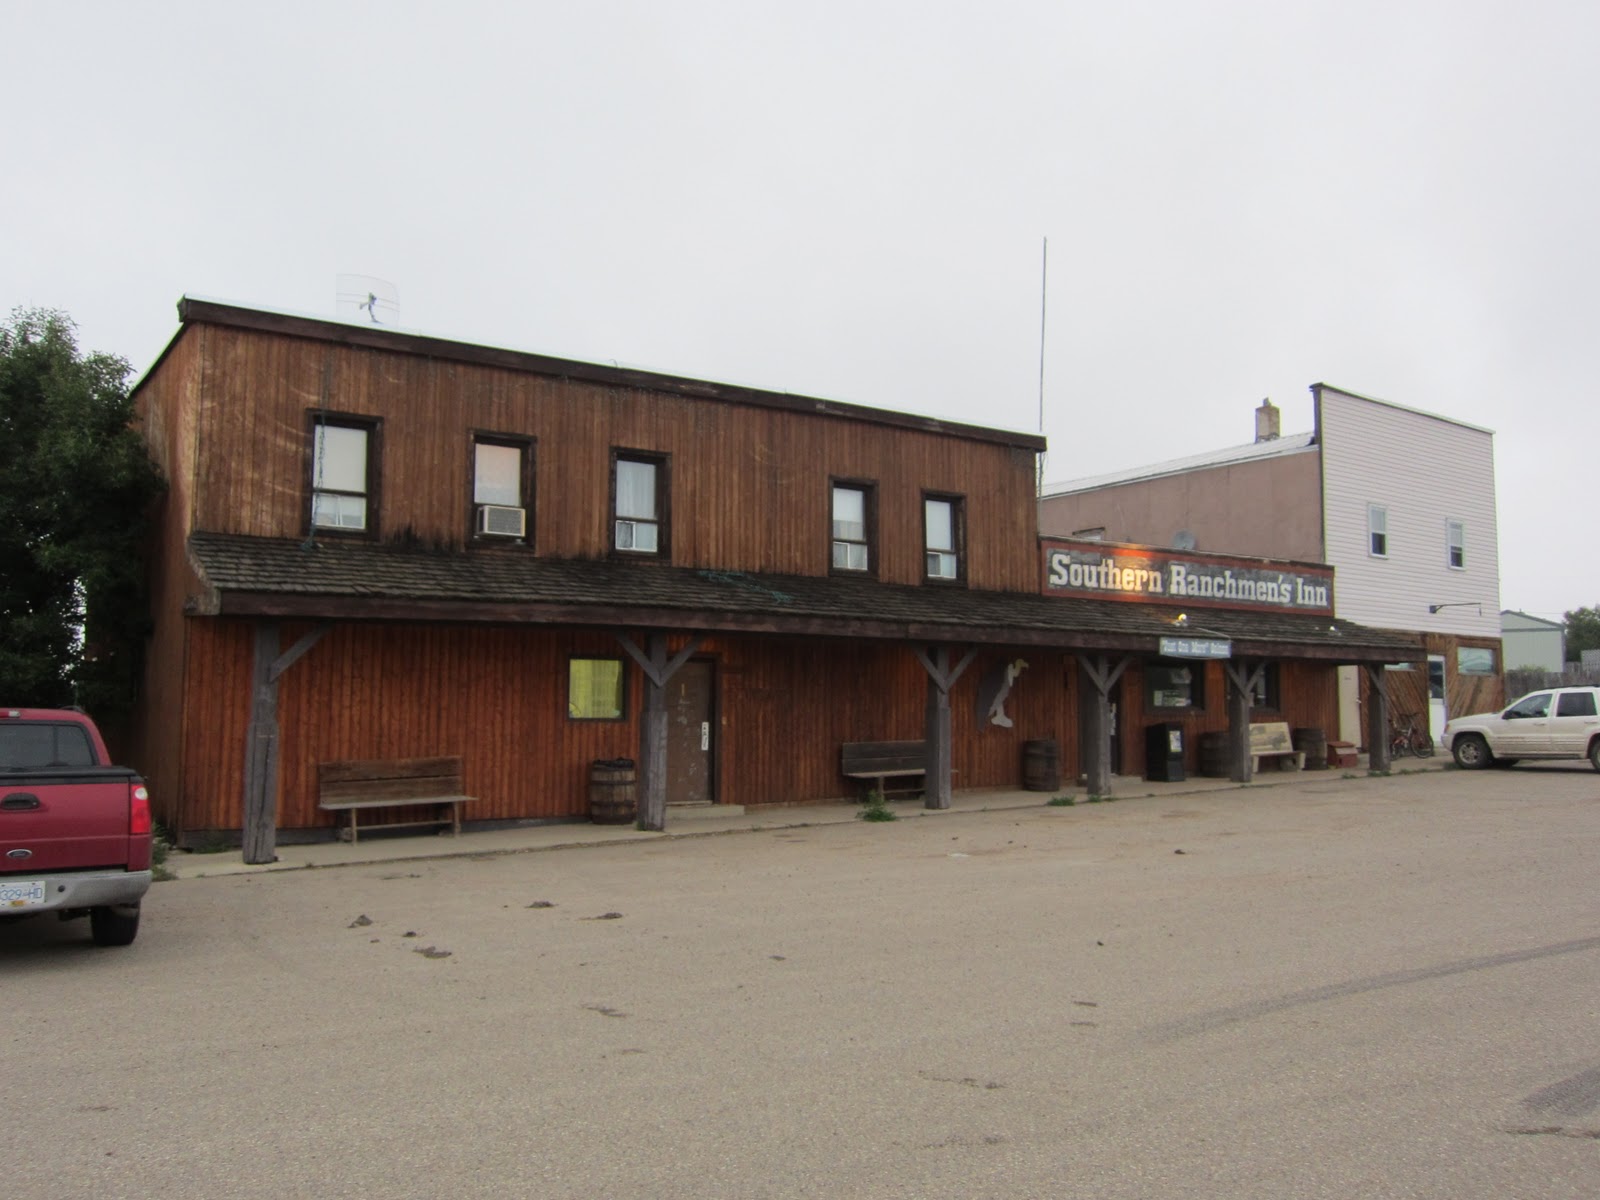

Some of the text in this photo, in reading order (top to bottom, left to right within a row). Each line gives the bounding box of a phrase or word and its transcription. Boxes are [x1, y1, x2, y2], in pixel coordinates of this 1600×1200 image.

[1049, 553, 1328, 606] Southern Ranchmen's Inn
